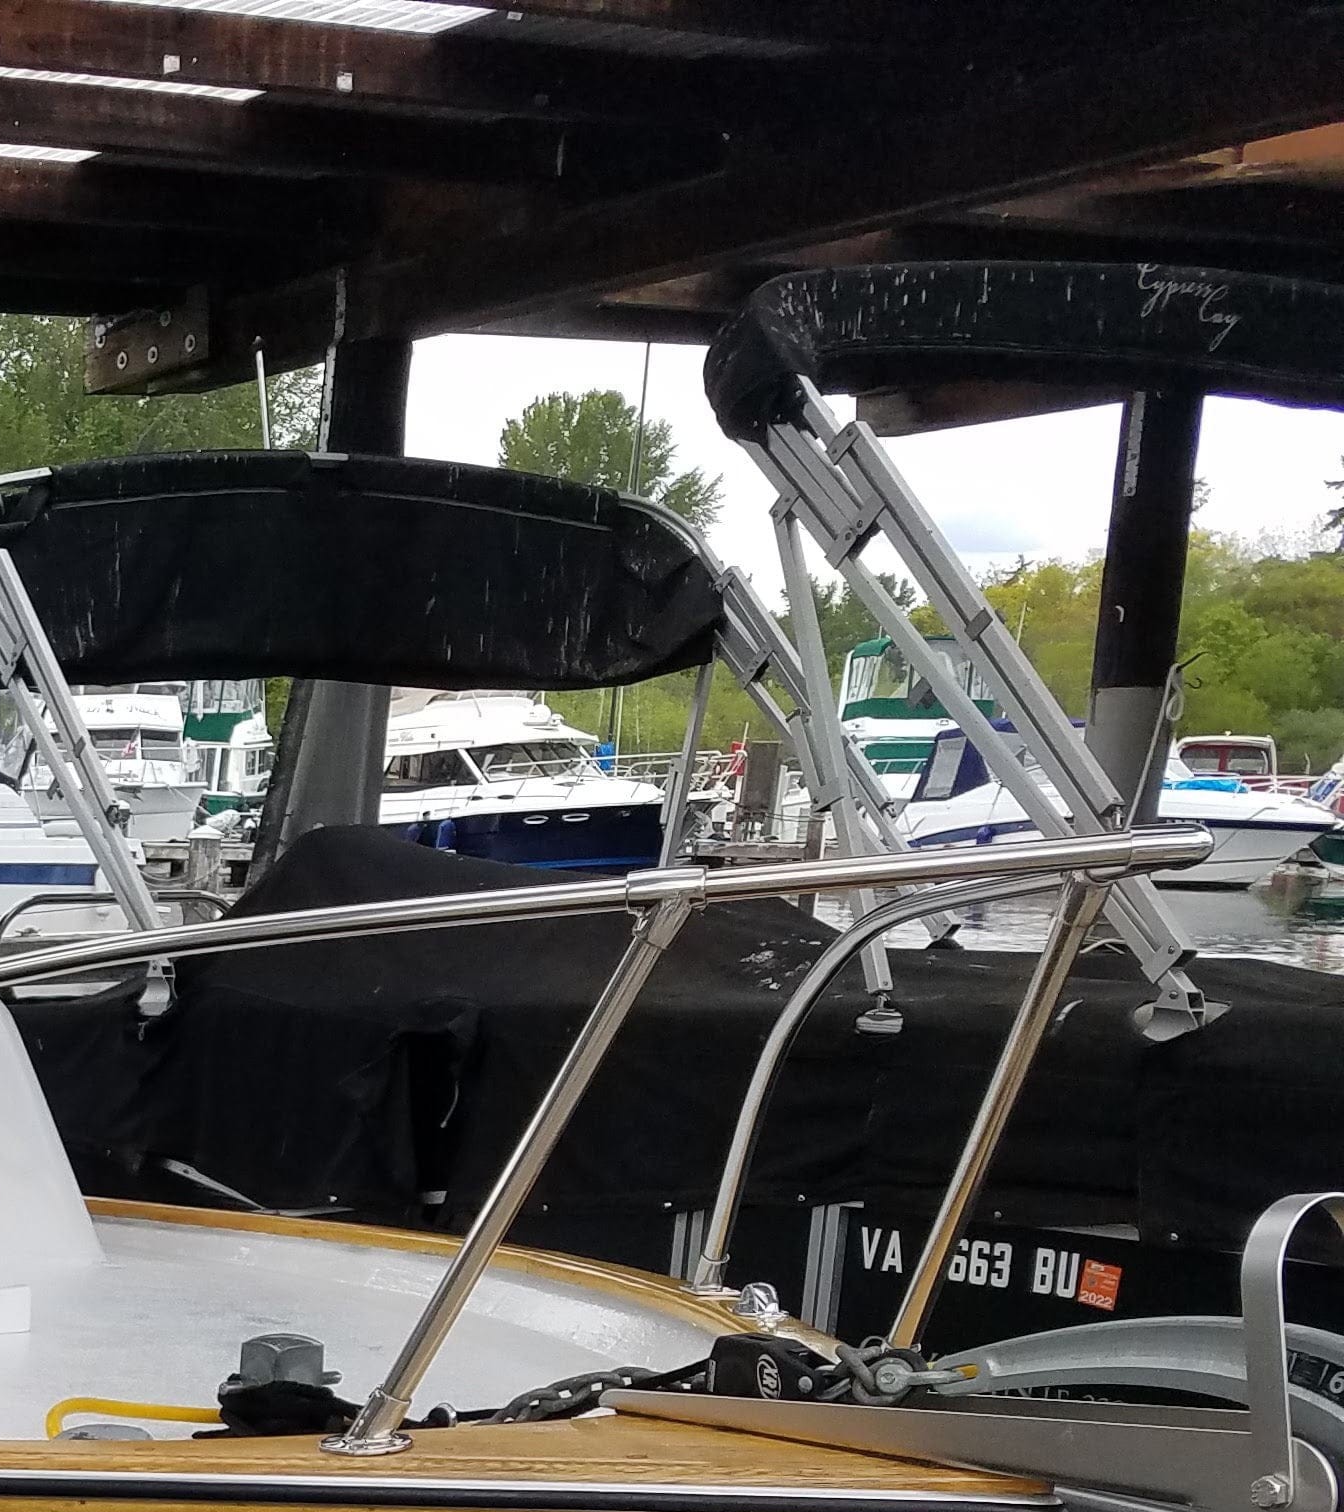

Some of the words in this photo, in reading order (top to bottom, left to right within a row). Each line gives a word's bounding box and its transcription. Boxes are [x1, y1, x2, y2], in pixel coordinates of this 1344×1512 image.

[861, 1226, 903, 1274] VA
[948, 1238, 1013, 1288] 663
[1032, 1247, 1080, 1299] BU
[1078, 1290, 1113, 1308] 2022
